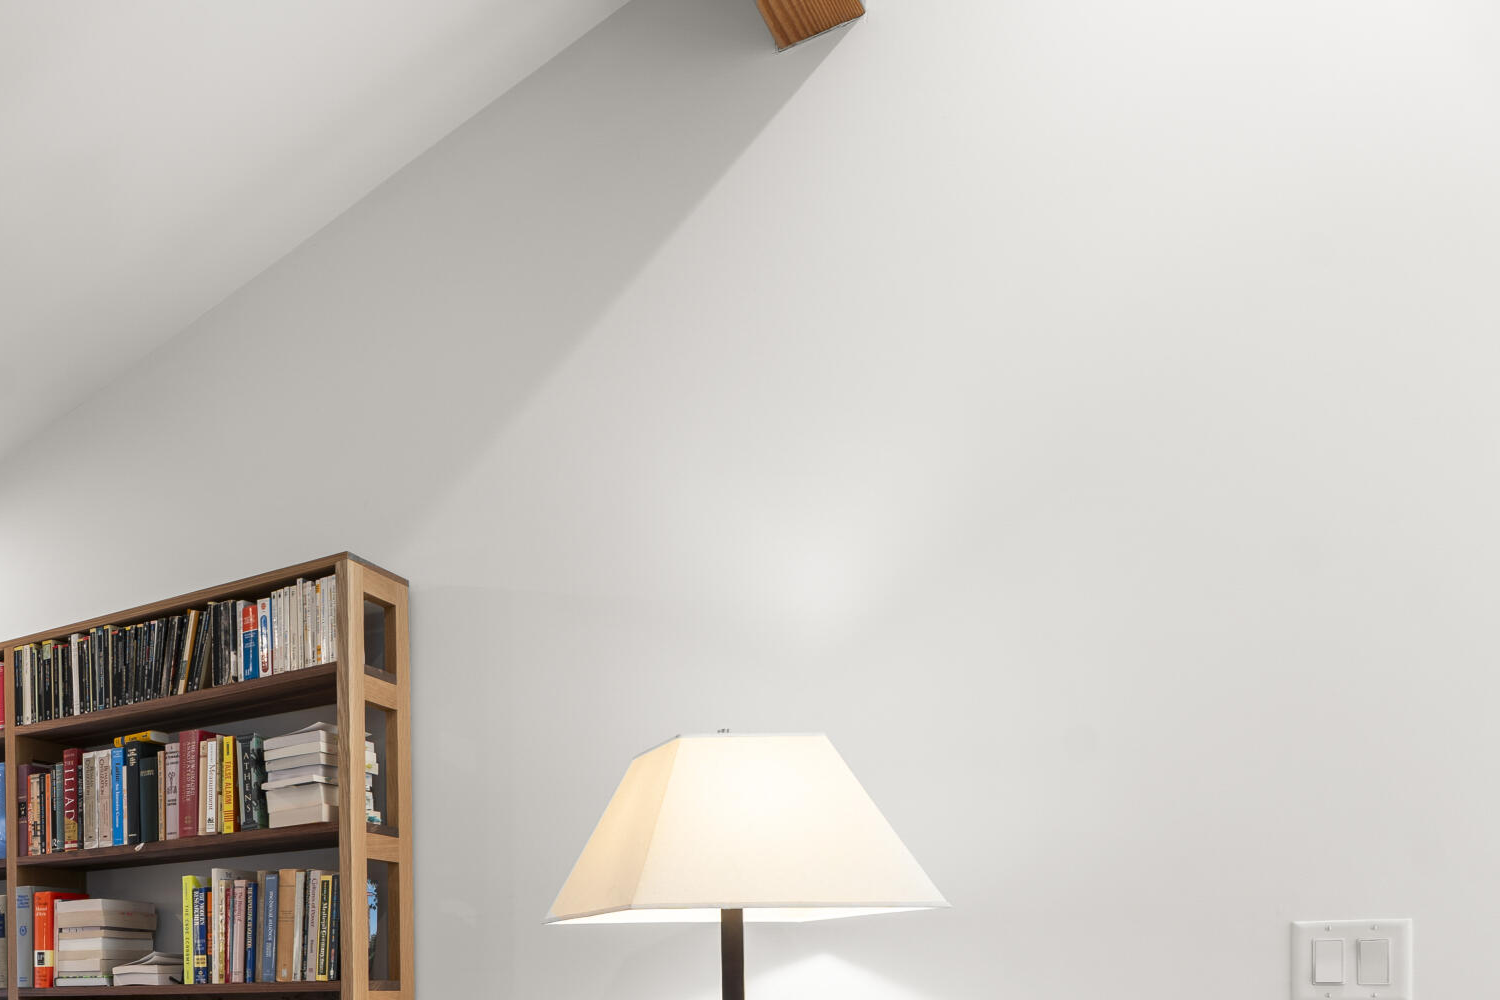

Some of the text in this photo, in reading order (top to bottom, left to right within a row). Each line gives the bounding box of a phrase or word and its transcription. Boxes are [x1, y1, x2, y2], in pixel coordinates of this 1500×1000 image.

[65, 768, 76, 821] ILIAD
[209, 764, 217, 811] Measurement
[243, 752, 253, 814] ATHENS
